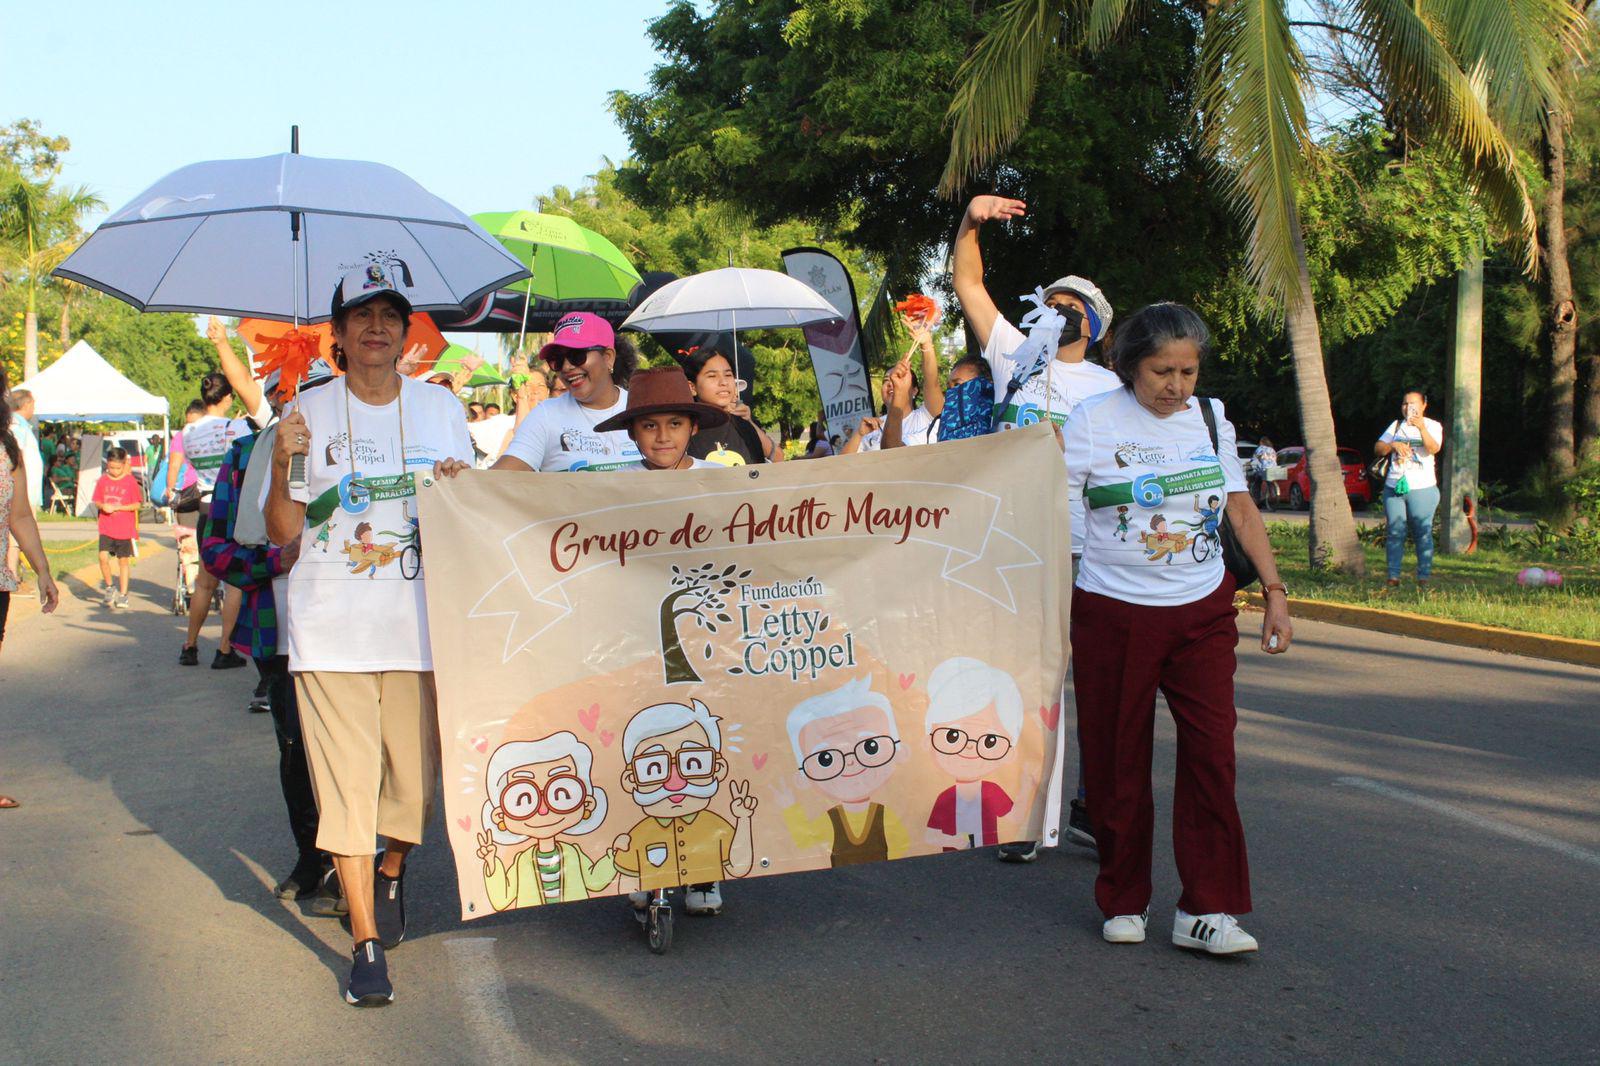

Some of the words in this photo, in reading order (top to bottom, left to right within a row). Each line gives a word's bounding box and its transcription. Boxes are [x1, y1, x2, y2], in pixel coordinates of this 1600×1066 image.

[826, 396, 871, 419] IMDEM
[356, 454, 385, 465] oppel
[371, 475, 414, 487] CAMINA
[1165, 471, 1201, 482] CAMINATA
[549, 521, 664, 573] Grupo
[669, 513, 713, 549] de
[722, 497, 836, 545] Adulto
[843, 491, 950, 545] Mayor
[740, 576, 823, 603] Fundación
[738, 603, 821, 644] Letty
[743, 633, 857, 682] Coppel
